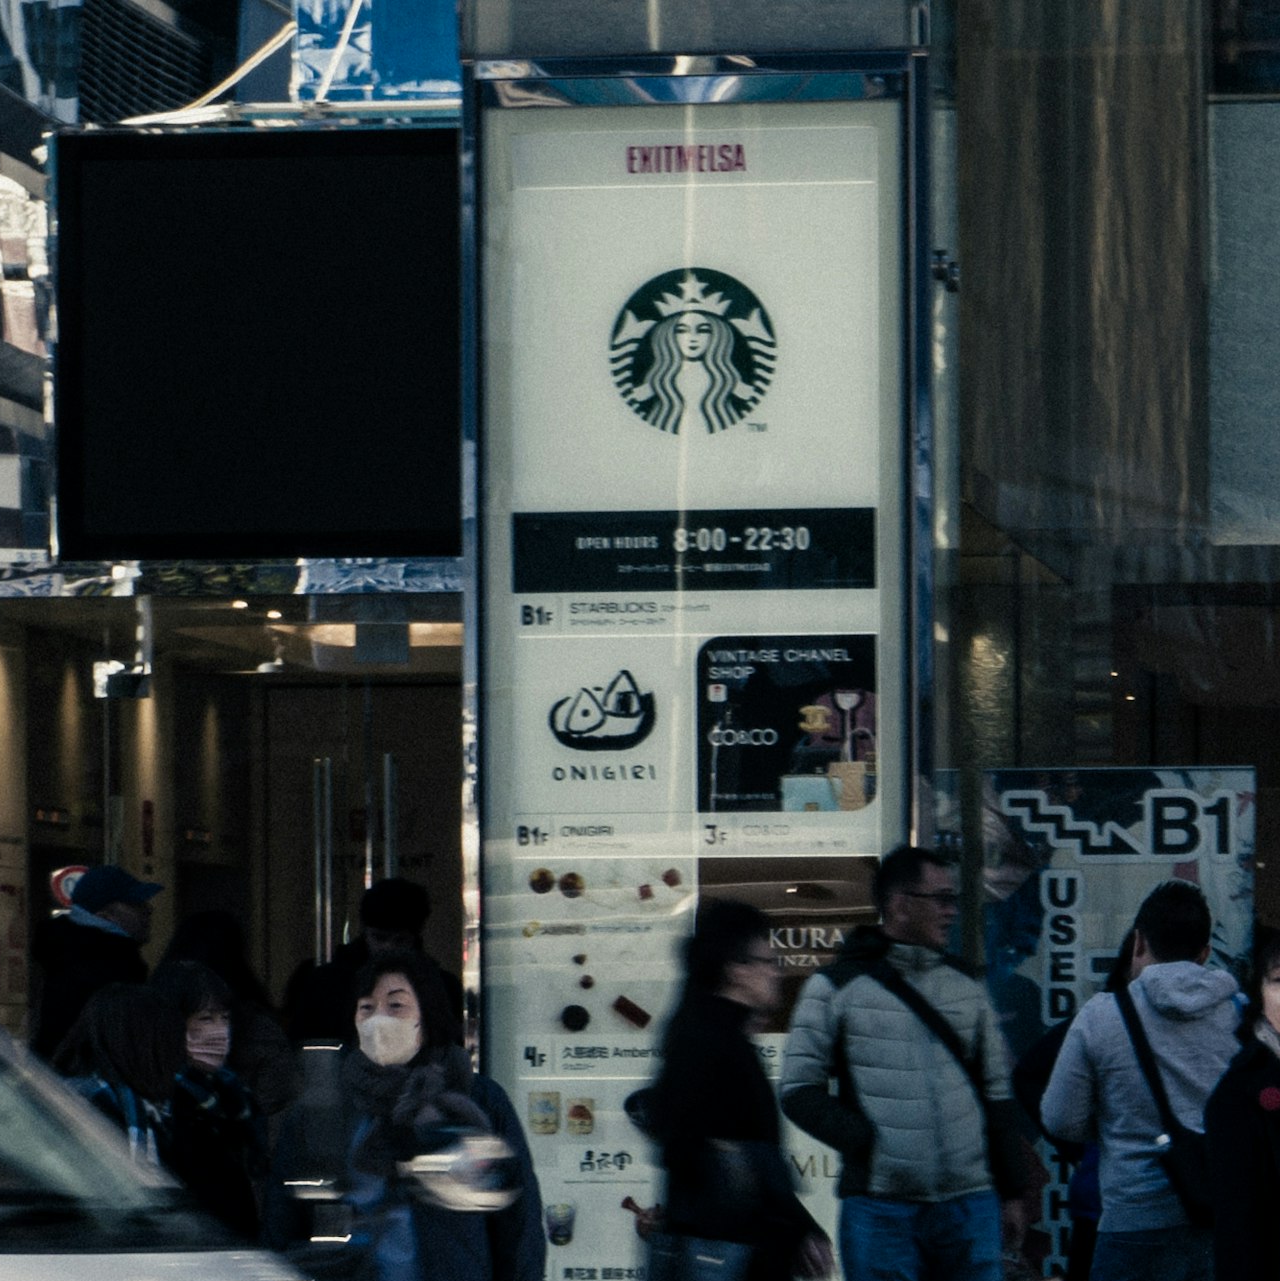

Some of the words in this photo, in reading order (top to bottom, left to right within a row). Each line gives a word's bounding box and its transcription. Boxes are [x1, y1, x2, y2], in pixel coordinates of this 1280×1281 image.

[575, 537, 612, 550] OPEN
[614, 536, 659, 549] HOURS
[569, 602, 657, 615] STARBUCKS
[707, 649, 779, 664] VINTAGE
[784, 648, 853, 663] CHANEL
[707, 666, 756, 680] SHOP
[552, 765, 657, 781] ONIGIRI
[561, 826, 614, 836] ONIGIRI
[1151, 796, 1231, 856] B1
[1048, 877, 1077, 1018] USED
